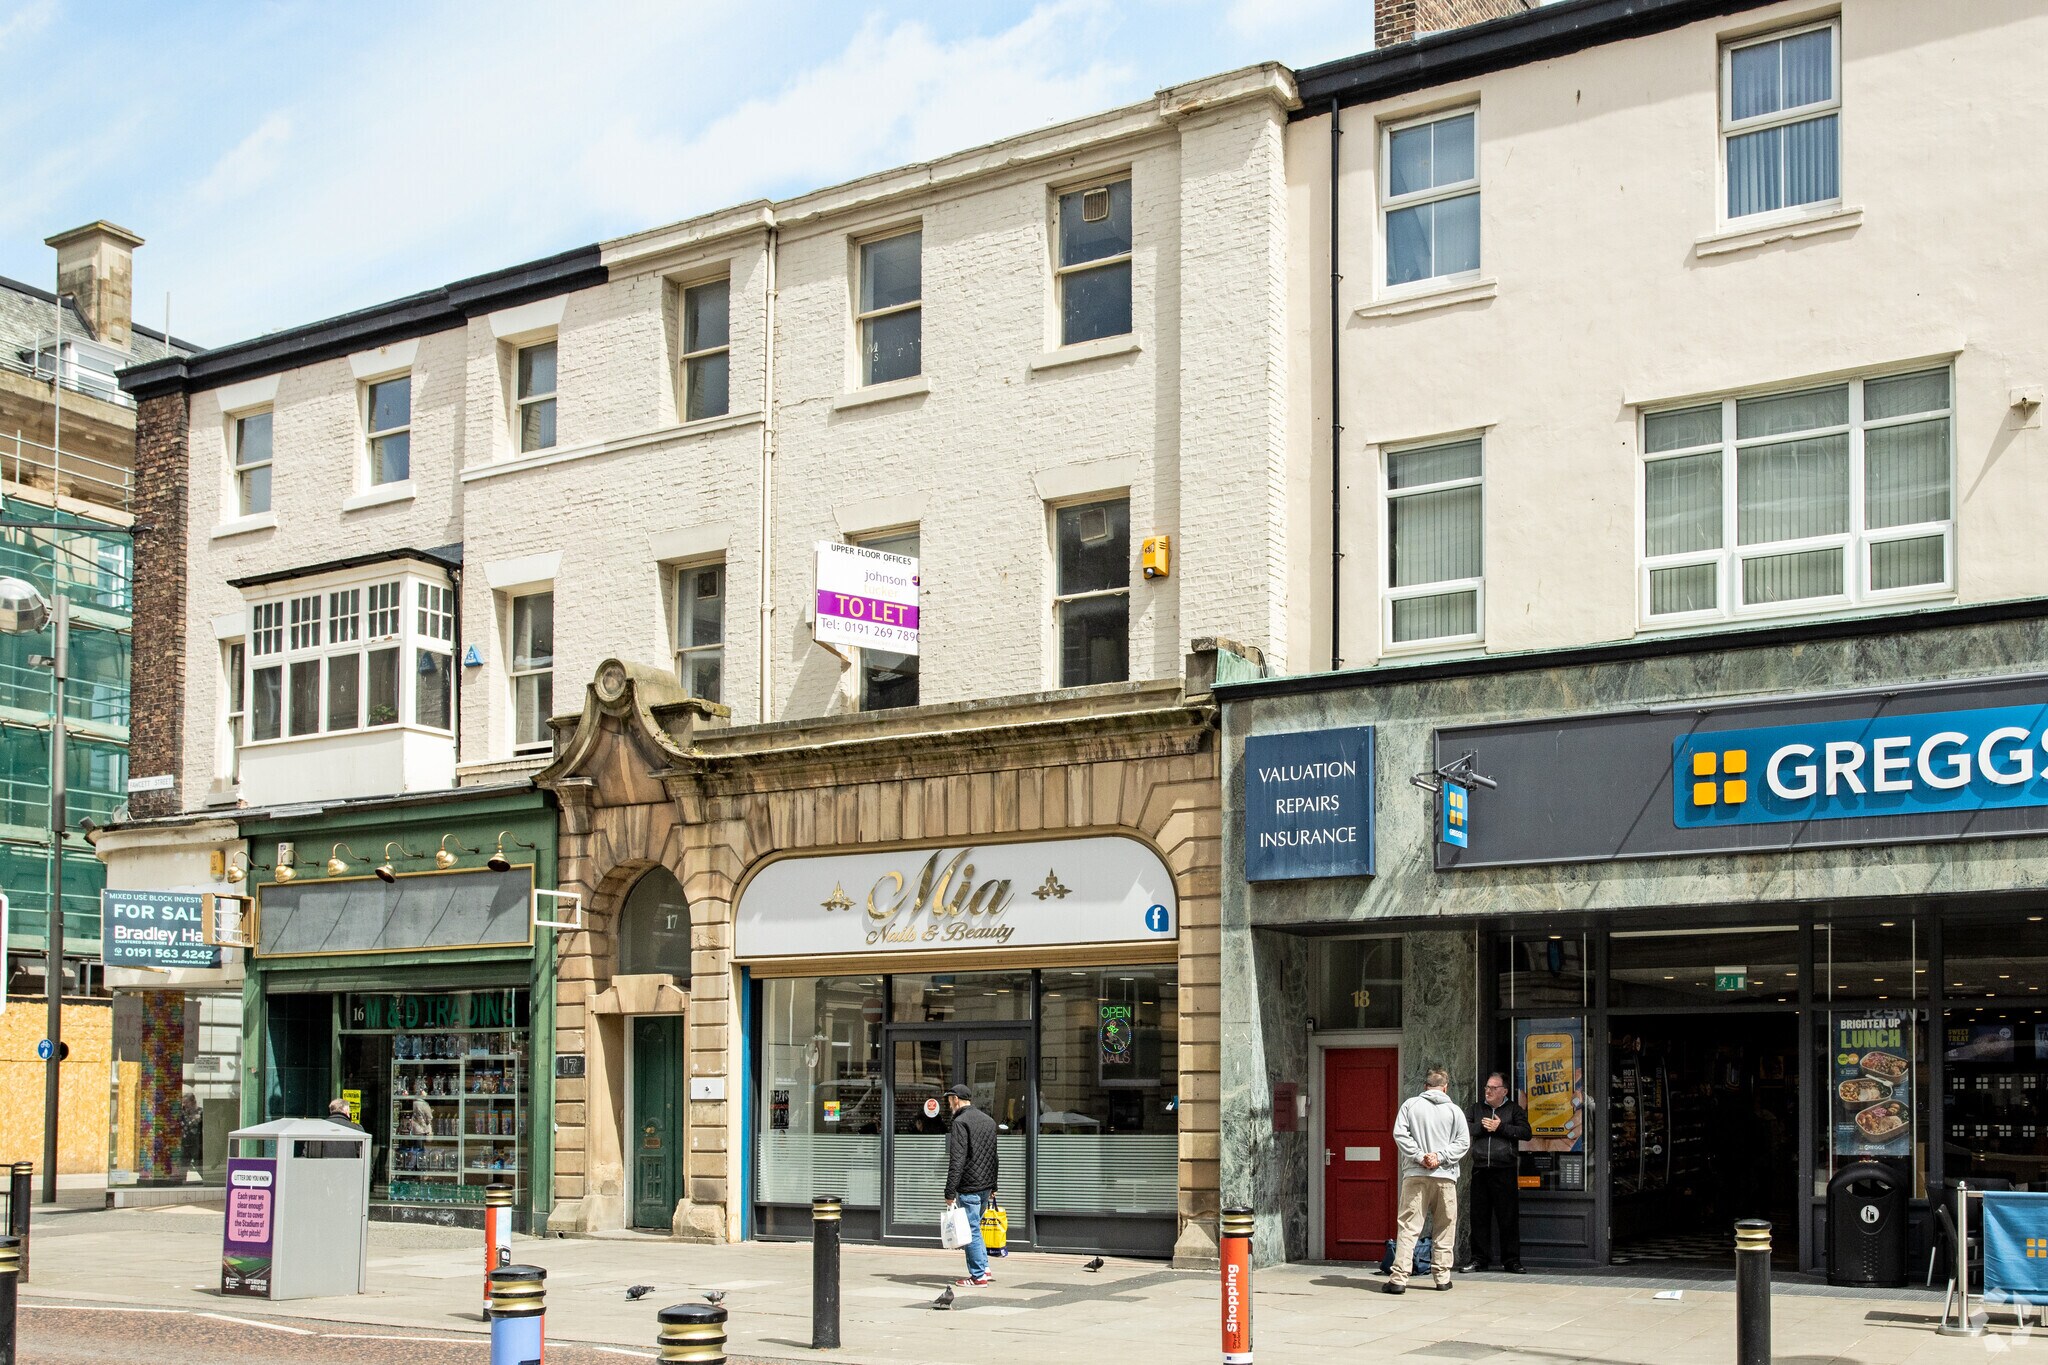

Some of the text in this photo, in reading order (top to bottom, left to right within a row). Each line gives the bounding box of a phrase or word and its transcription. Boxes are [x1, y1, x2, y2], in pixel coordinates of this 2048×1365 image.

[831, 544, 912, 566] UPPER FLOOR OFFICES
[864, 570, 907, 587] johnson
[864, 584, 897, 598] tucker
[835, 594, 909, 625] TO LET
[821, 617, 840, 631] Tel:
[844, 621, 869, 635] 0191
[874, 626, 893, 638] 269
[1766, 725, 2048, 800] GREGG
[1258, 760, 1356, 784] VALUATION
[1276, 795, 1340, 815] REPAIRS
[1260, 827, 1357, 848] INSURANCE
[866, 848, 1015, 921] Mia
[109, 893, 132, 901] MIXED
[133, 893, 147, 901] USE
[113, 904, 203, 921] FOR SAL
[666, 914, 679, 930] 17
[114, 925, 178, 946] Bradley
[865, 921, 1015, 946] Nails & Beauty
[125, 947, 214, 960] 0191 563 4242
[1350, 990, 1370, 1008] 18
[353, 1007, 365, 1022] 16
[365, 998, 381, 1029] M
[405, 995, 420, 1028] D
[423, 991, 516, 1028] TRADING
[1101, 1006, 1131, 1018] OPEN
[1840, 1019, 1901, 1030] BRIGHTEN UP
[1841, 1029, 1901, 1049] LUNCH
[1101, 1050, 1131, 1064] NAILS
[563, 1058, 578, 1074] 17
[1534, 1059, 1564, 1073] STEAK
[1531, 1081, 1570, 1097] COLLECT
[237, 1192, 248, 1200] Each
[236, 1210, 247, 1218] litter
[248, 1203, 264, 1211] enough
[237, 1229, 248, 1238] Light
[1225, 1264, 1240, 1333] Shopping
